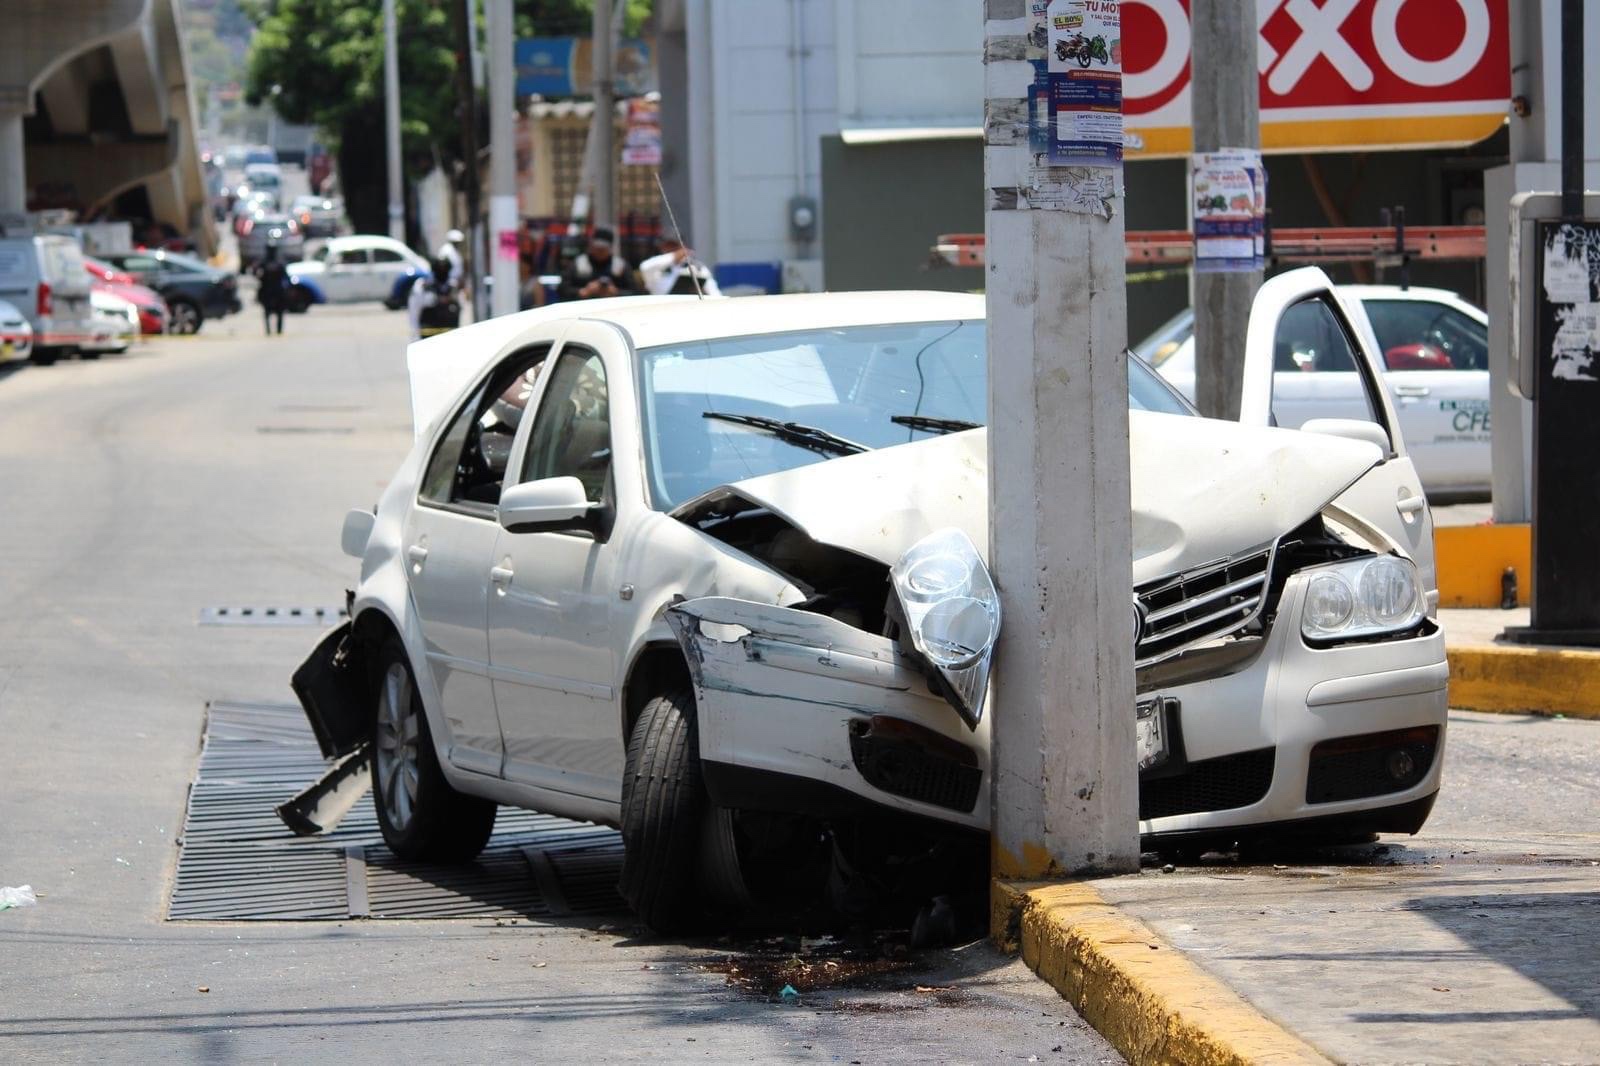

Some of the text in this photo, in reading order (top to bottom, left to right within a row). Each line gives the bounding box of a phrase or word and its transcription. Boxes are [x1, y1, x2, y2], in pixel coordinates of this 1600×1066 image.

[1085, 1, 1121, 14] TU MOT
[1453, 410, 1492, 432] CFE
